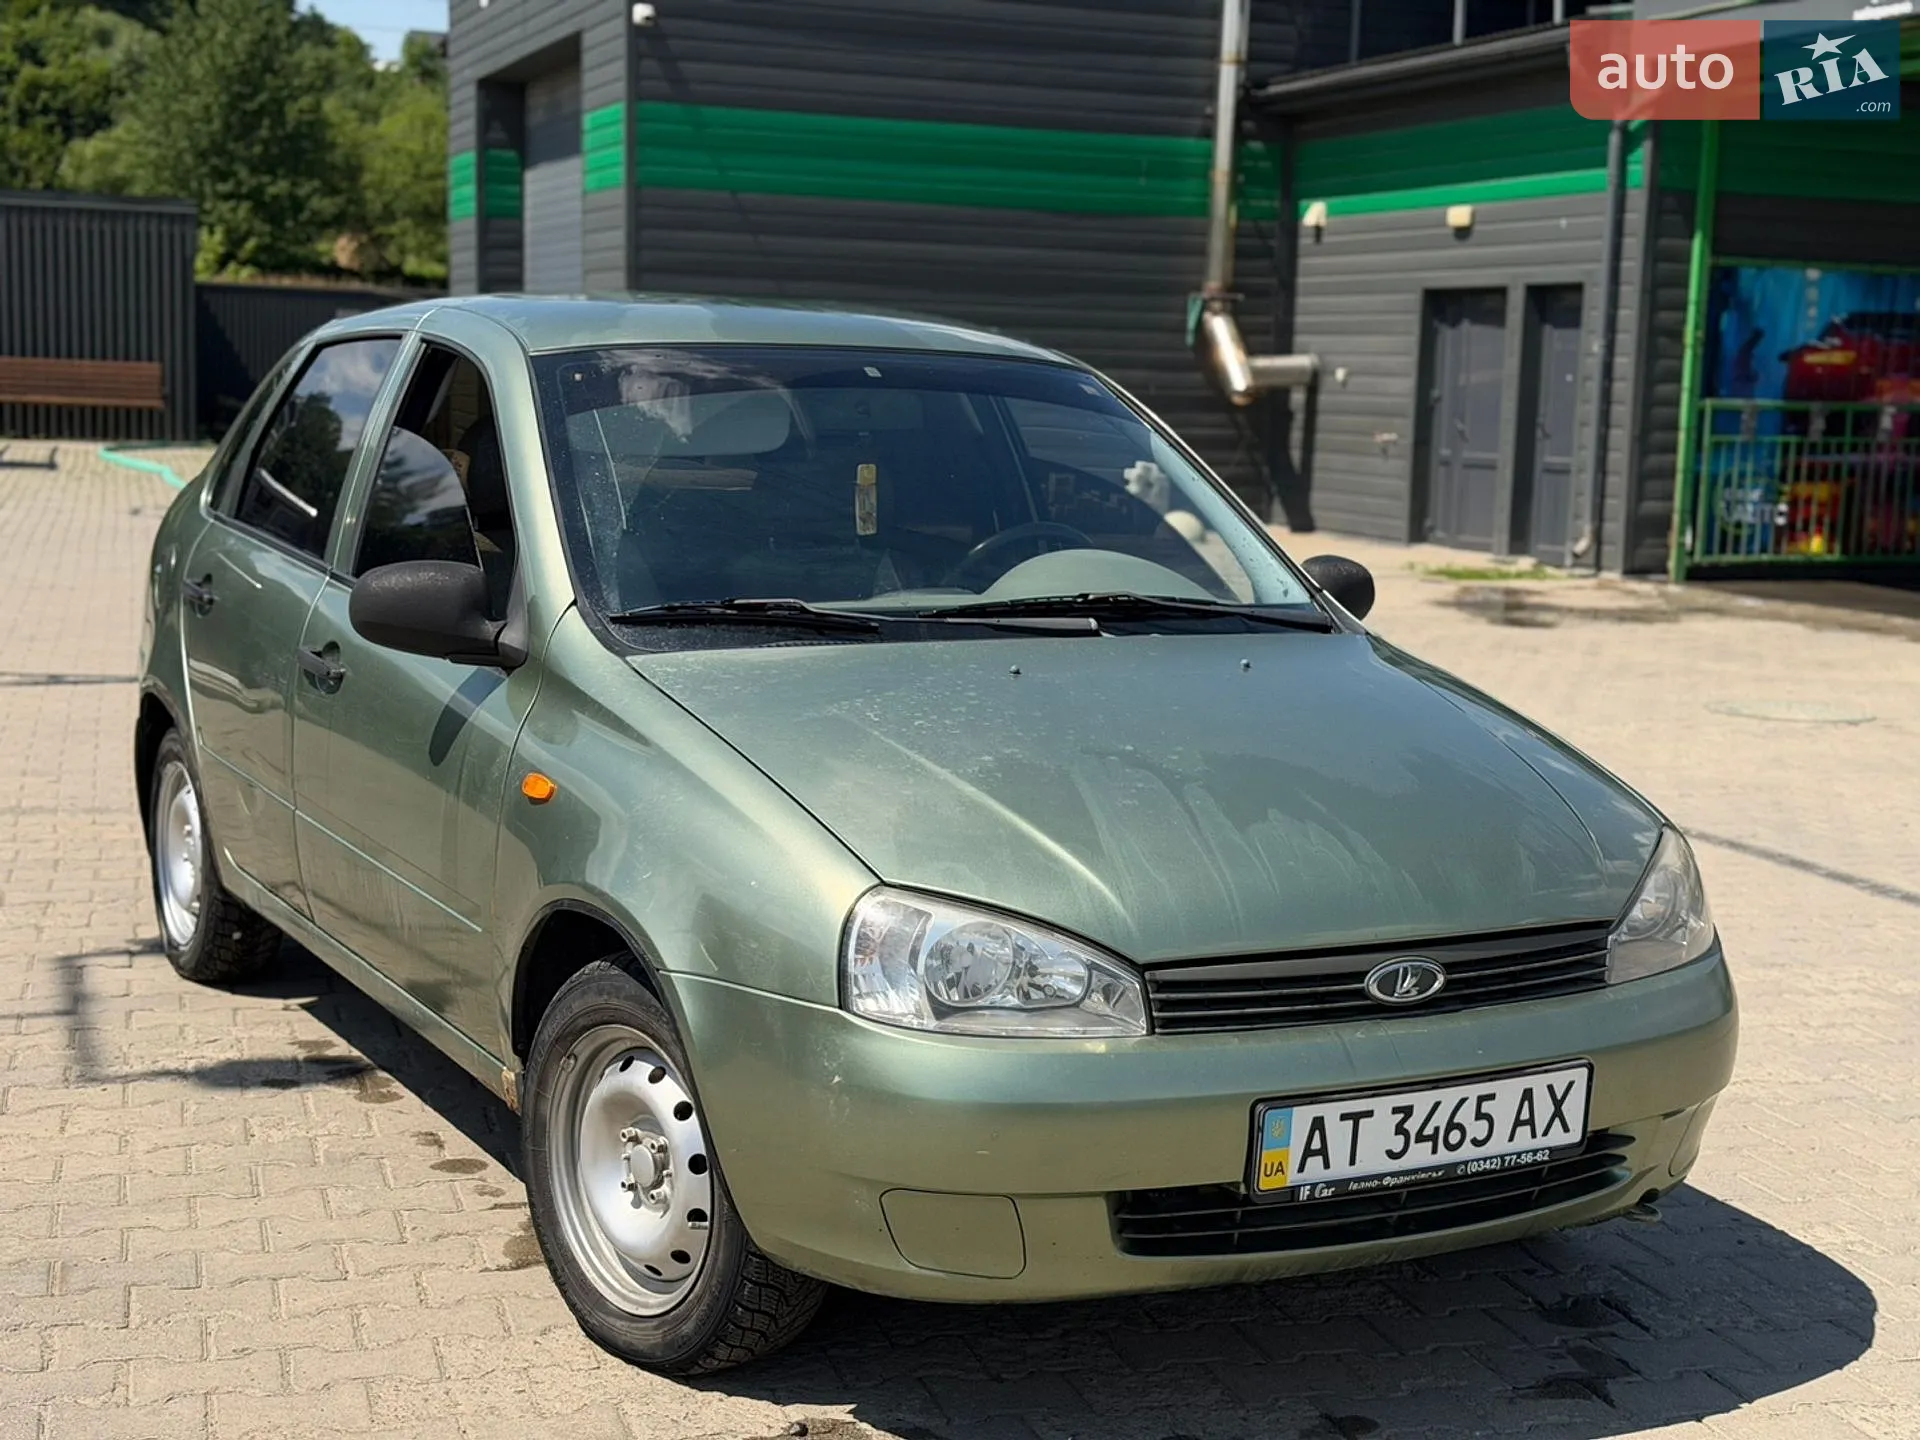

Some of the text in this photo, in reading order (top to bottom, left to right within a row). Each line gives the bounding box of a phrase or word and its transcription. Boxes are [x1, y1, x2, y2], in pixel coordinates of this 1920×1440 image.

[1297, 1080, 1575, 1174] AT 3465 AX
[1263, 1161, 1285, 1178] UA
[1466, 1149, 1550, 1175] (0342) 77-56-62
